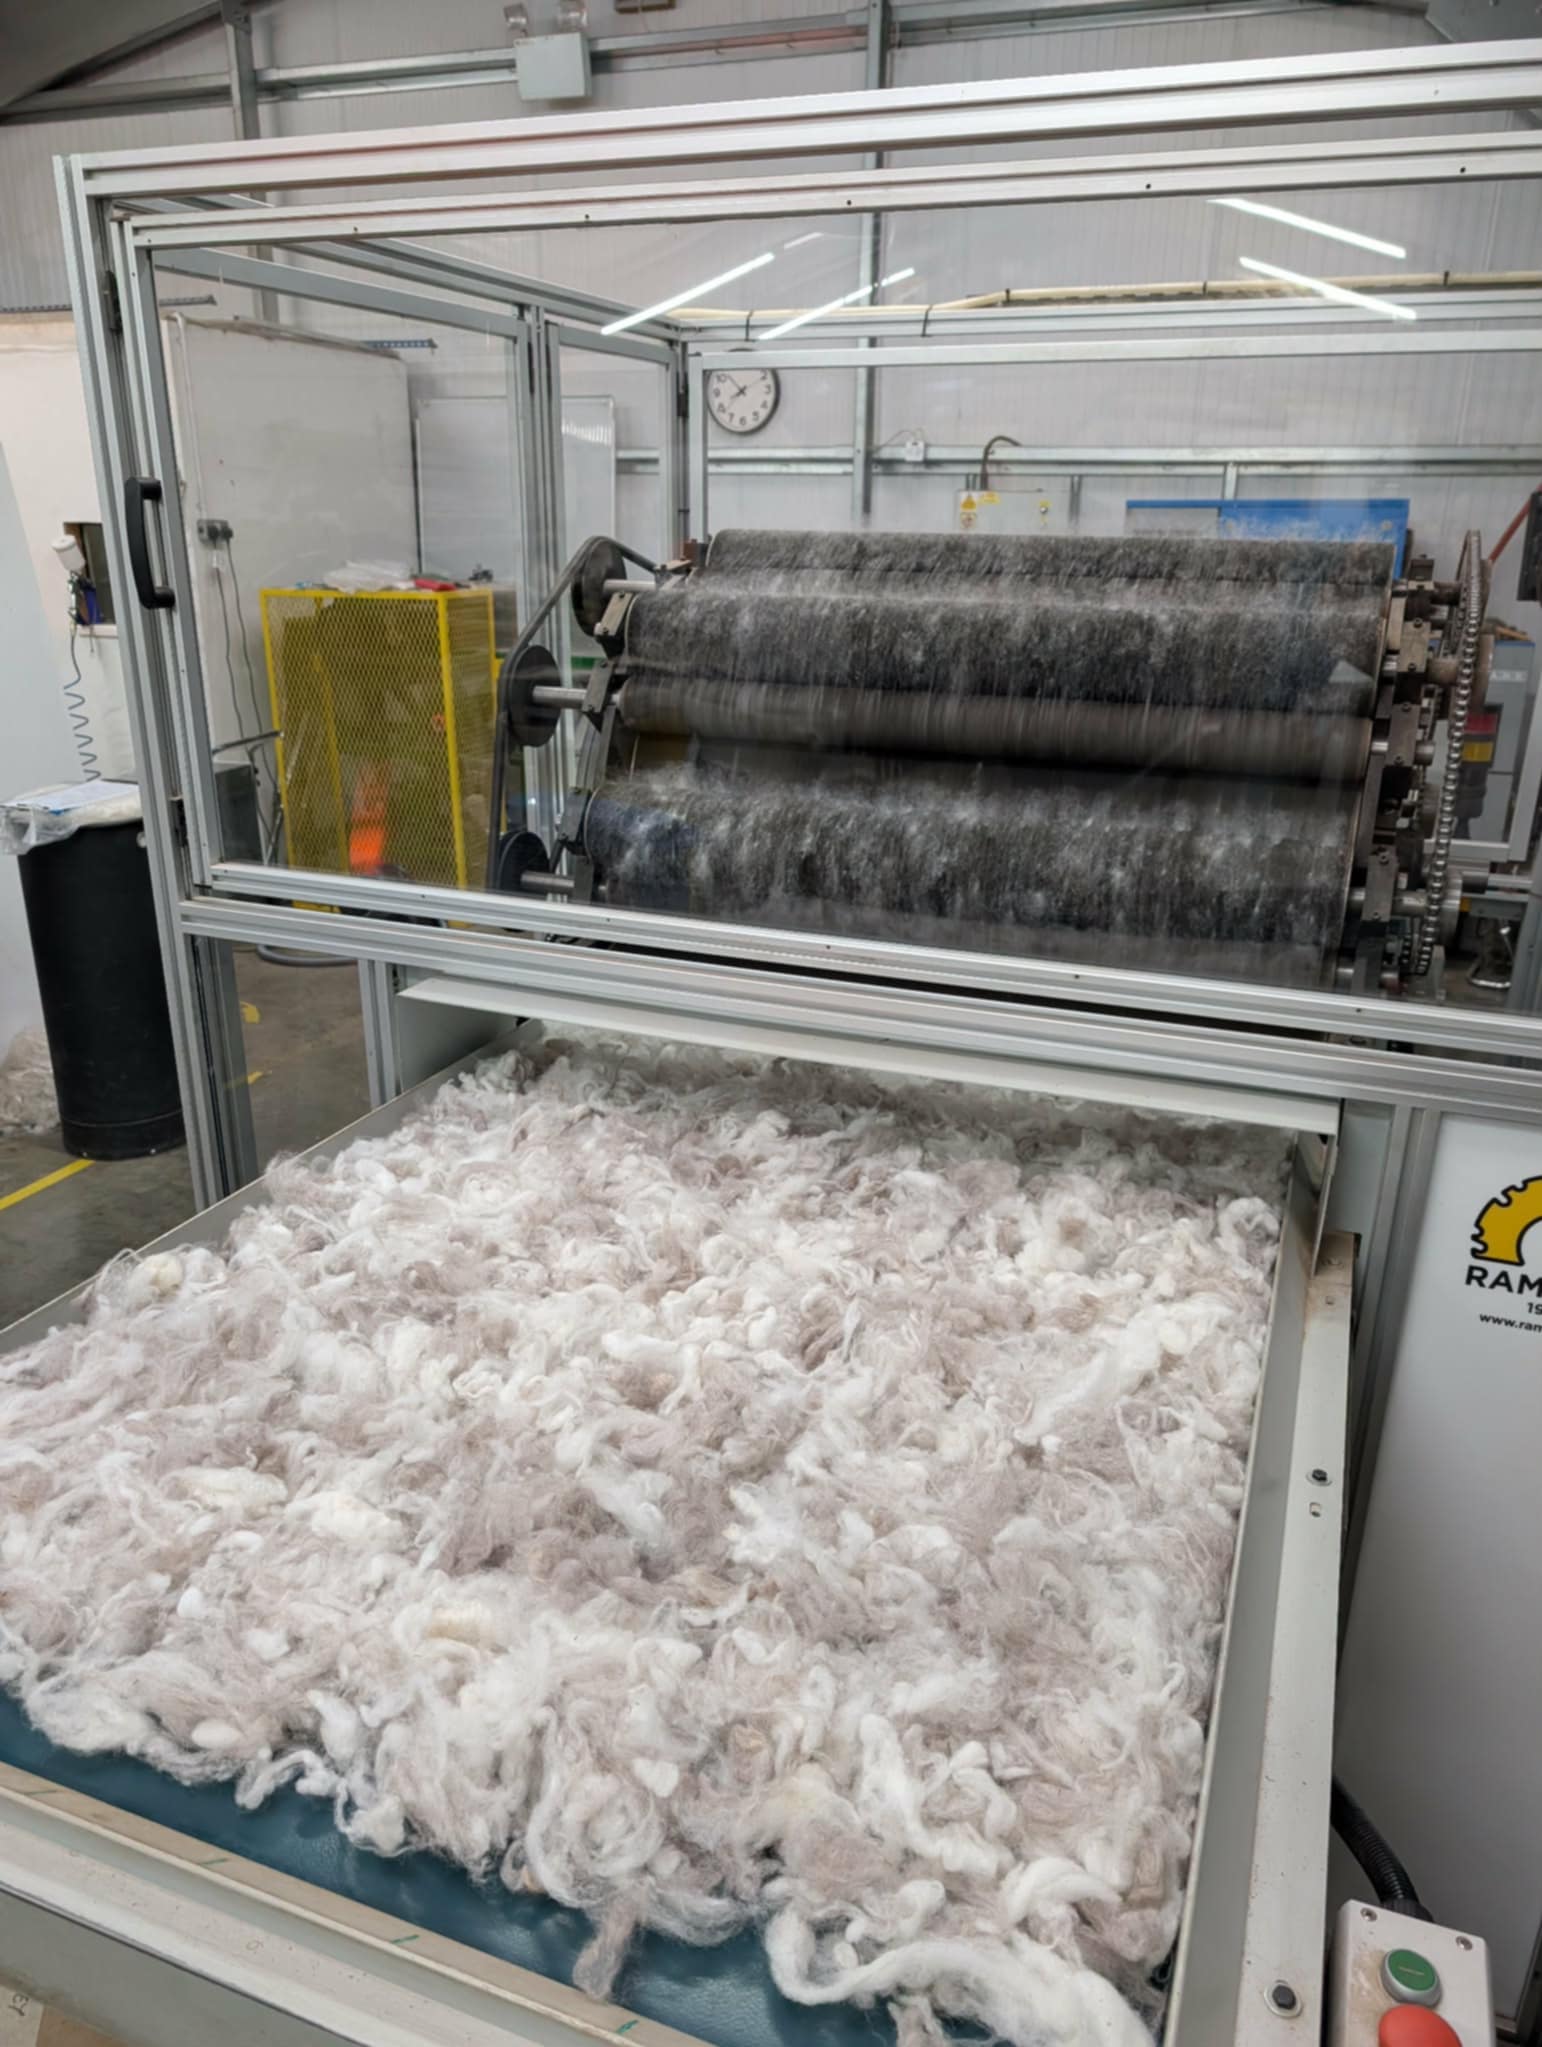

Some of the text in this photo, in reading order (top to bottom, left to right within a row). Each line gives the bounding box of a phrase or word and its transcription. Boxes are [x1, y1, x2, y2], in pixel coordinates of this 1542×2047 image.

[713, 387, 721, 398] 9
[764, 384, 771, 395] 3
[718, 402, 726, 414] 8
[760, 400, 768, 409] 4
[728, 412, 735, 423] 7
[739, 416, 747, 426] 6
[752, 411, 759, 422] 5
[1465, 1265, 1542, 1298] RAM
